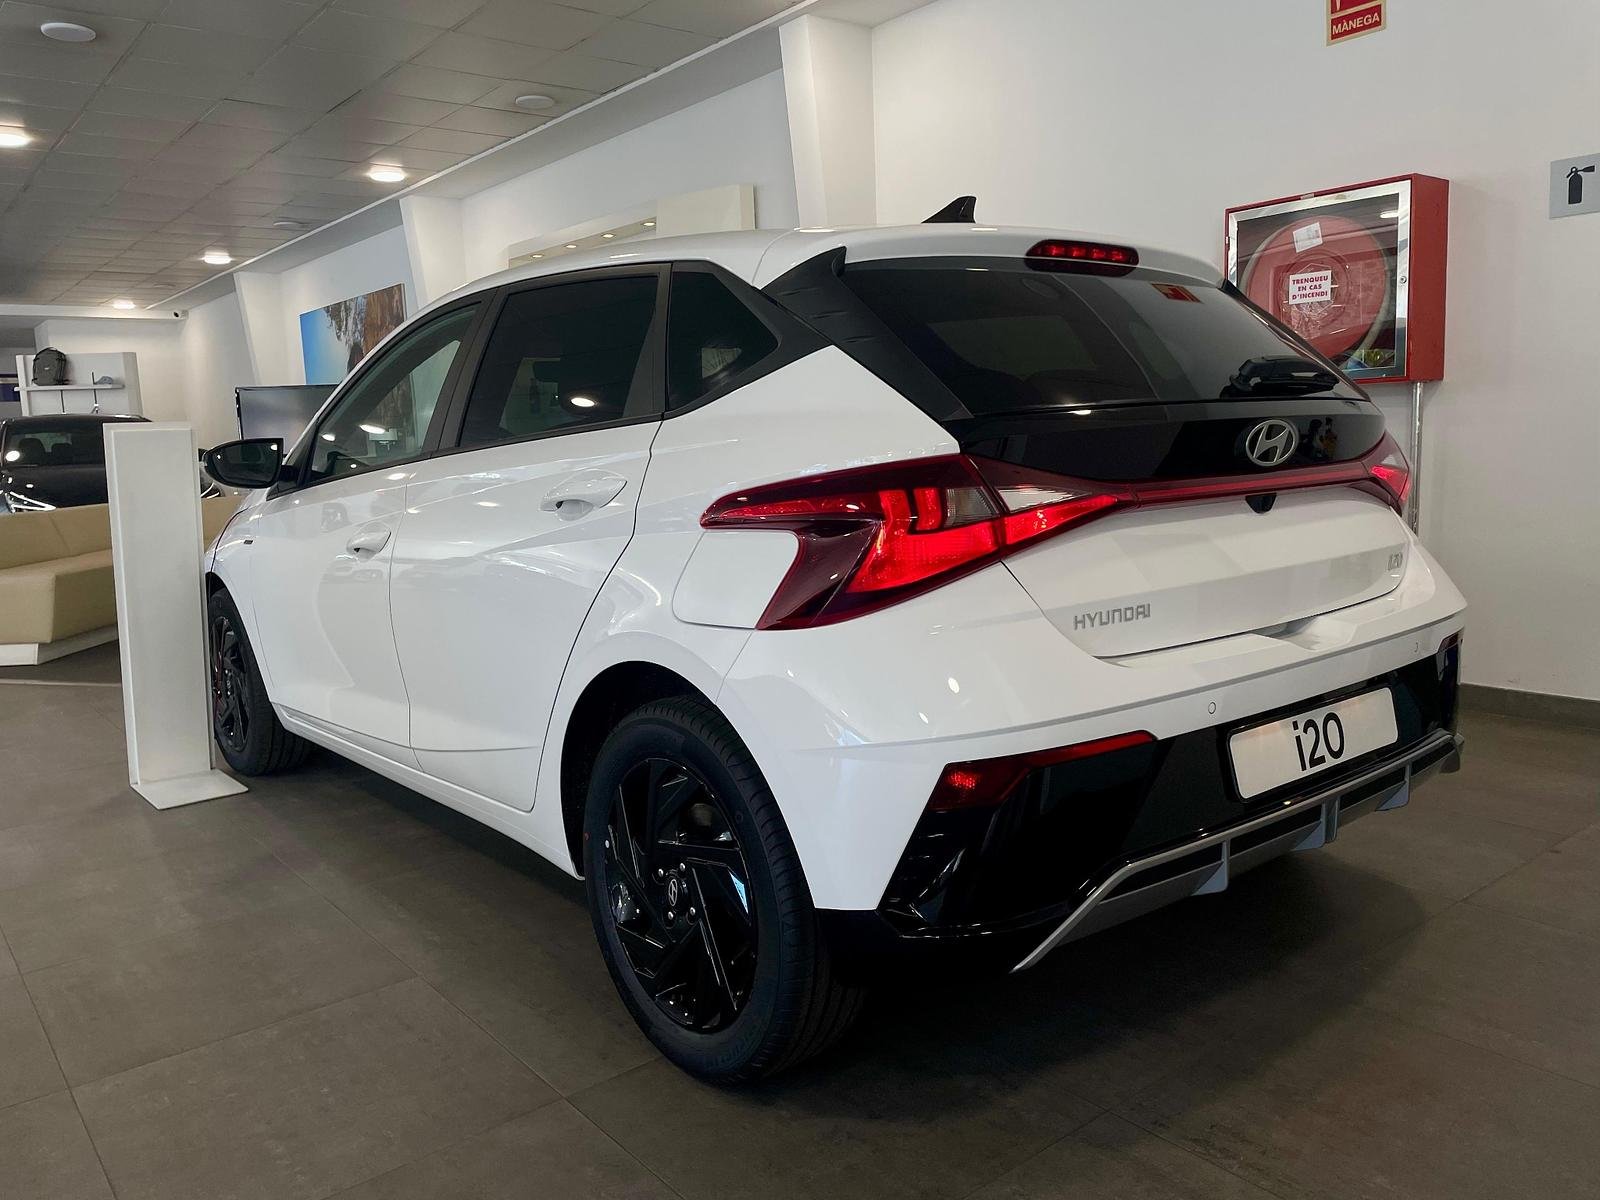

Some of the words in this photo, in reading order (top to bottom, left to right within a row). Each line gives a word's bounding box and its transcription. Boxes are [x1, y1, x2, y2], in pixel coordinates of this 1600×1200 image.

[1332, 12, 1380, 35] MÀNEGA
[1292, 276, 1328, 285] TRENQUEU
[1292, 290, 1328, 300] D'INCENDI
[1073, 603, 1151, 631] HYUNDAI
[1292, 712, 1345, 772] i20
